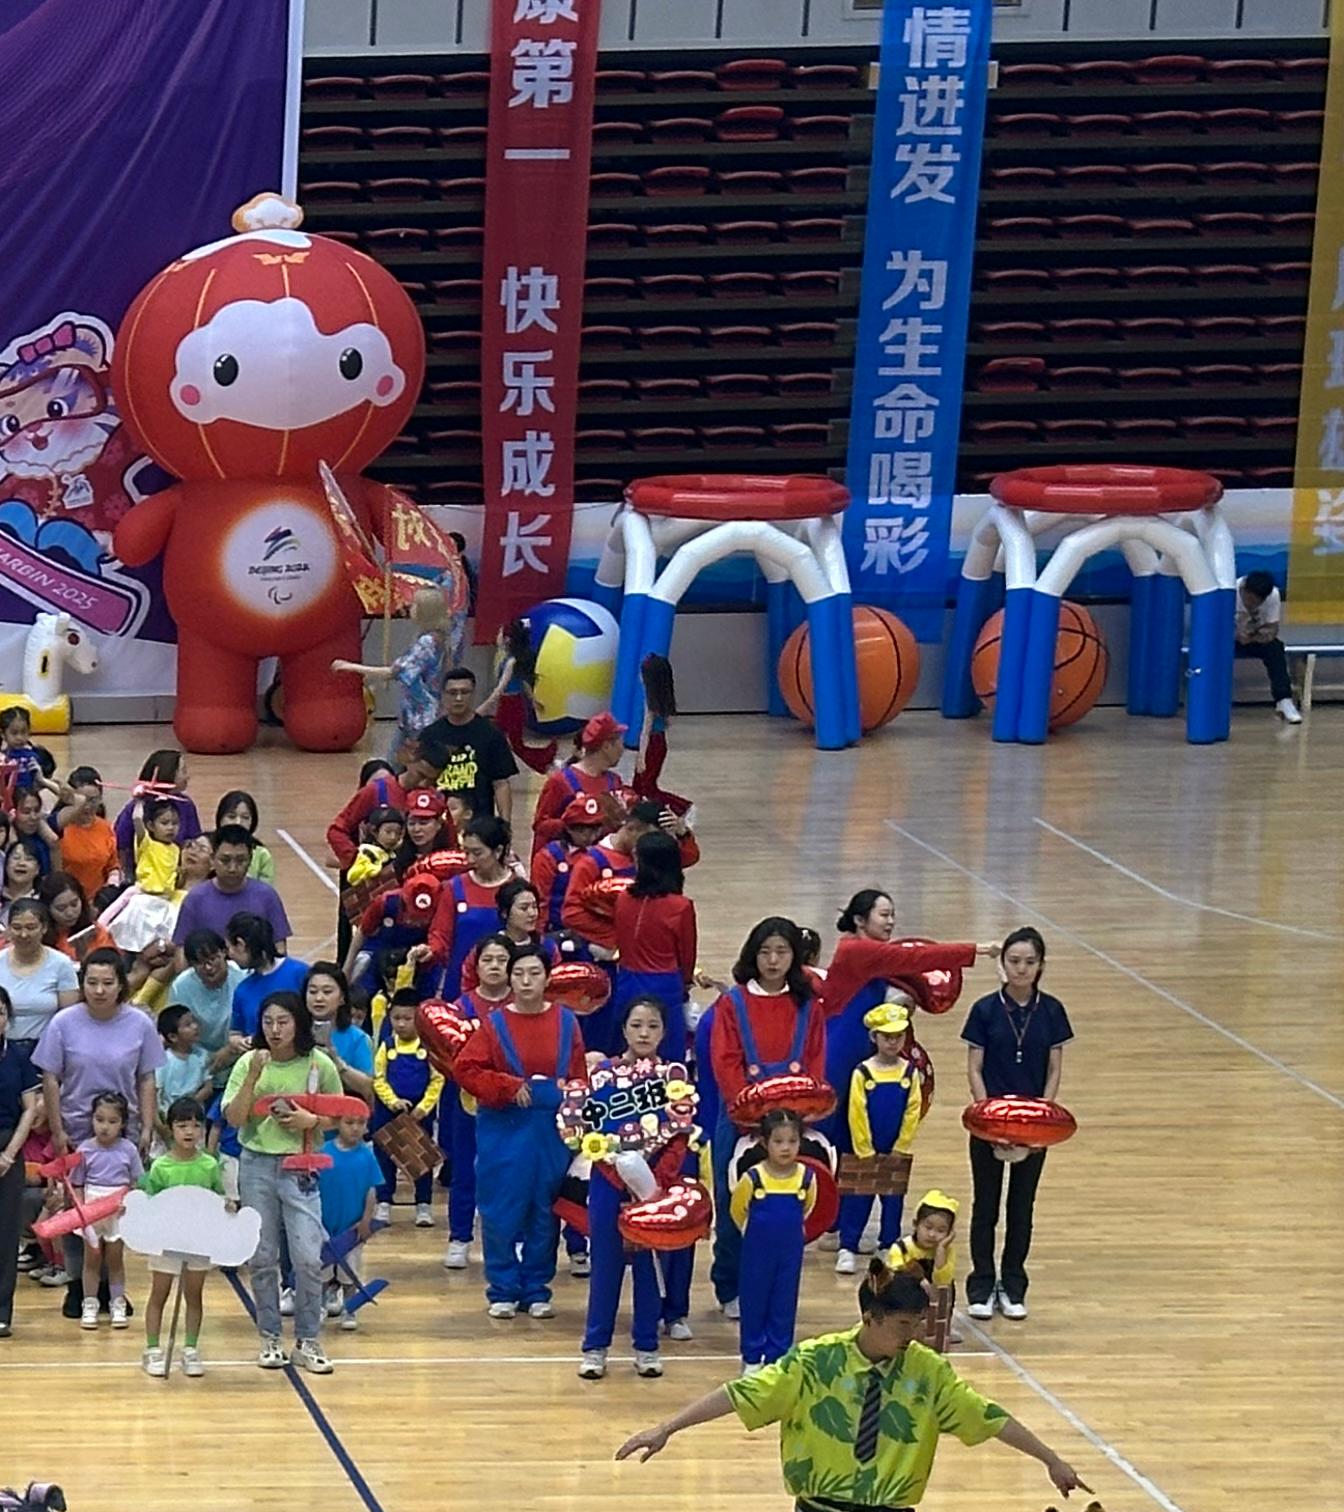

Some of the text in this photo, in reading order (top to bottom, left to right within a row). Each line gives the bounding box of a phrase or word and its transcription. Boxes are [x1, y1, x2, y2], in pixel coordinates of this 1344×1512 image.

[860, 7, 972, 575] 情进发 为生命喝彩
[499, 266, 561, 577] 快乐成长
[51, 582, 100, 610] 2025
[582, 1080, 668, 1130] 中二班
